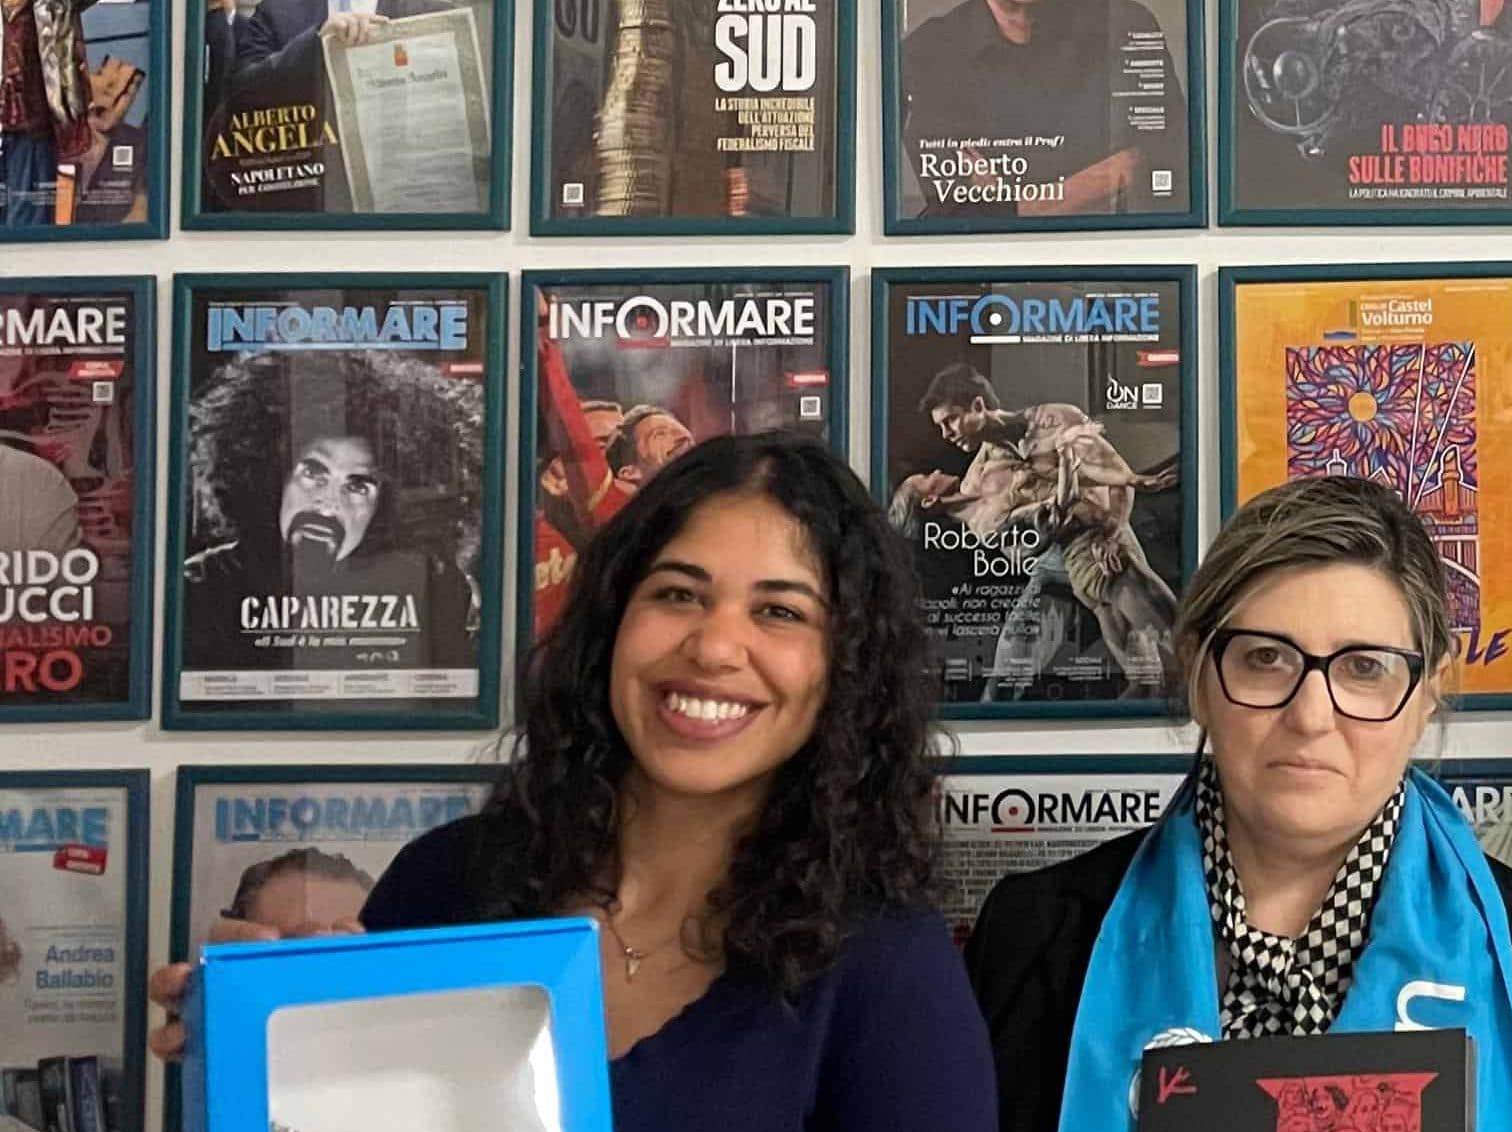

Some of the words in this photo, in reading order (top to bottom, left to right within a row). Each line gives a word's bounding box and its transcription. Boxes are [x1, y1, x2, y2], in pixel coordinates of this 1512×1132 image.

[715, 13, 816, 92] SUD
[231, 105, 315, 130] ALBERTO
[212, 121, 338, 160] ANGELA
[1382, 124, 1399, 153] IL
[231, 163, 325, 184] NAPOLETANO
[919, 150, 1028, 178] Roberto
[1349, 156, 1405, 184] SULLE
[1409, 155, 1509, 184] BONIFICHE
[933, 176, 1065, 203] Vecchioni
[550, 296, 814, 339] INFORMARE
[906, 294, 1160, 335] INFORMARE
[1362, 311, 1433, 326] Volturno
[1388, 298, 1432, 313] Castel
[207, 305, 468, 351] INFORMARE
[1106, 376, 1139, 402] ON
[924, 522, 1040, 550] Roberto
[973, 549, 1039, 577] Bolle
[240, 594, 418, 630] CAPAREZZA
[945, 788, 1160, 824] NFORMARE
[46, 945, 114, 962] Andrea
